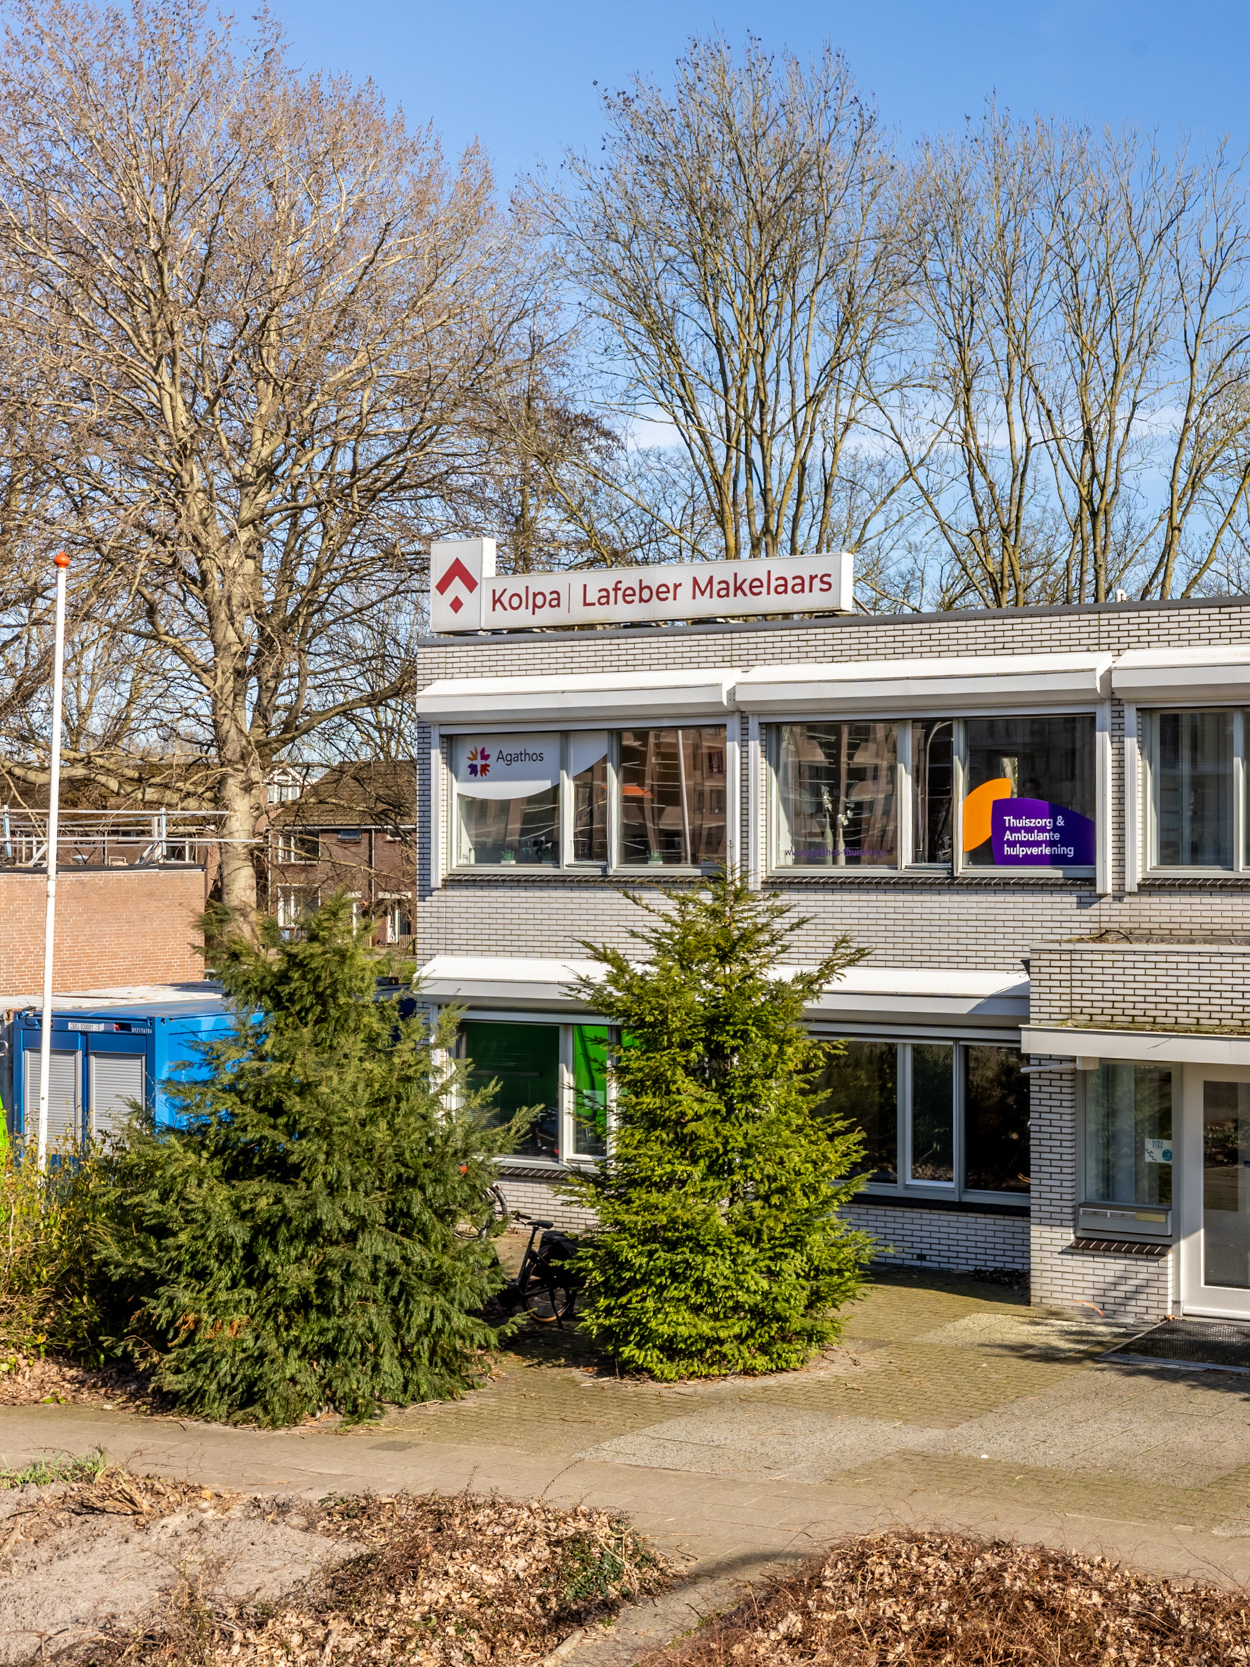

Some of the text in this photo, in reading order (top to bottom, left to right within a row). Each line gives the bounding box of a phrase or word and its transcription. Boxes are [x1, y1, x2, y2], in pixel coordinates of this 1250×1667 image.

[491, 586, 561, 615] Kolpa
[582, 579, 683, 608] Lafeber
[691, 570, 833, 600] Makelaars
[496, 748, 545, 766] Agathos
[1004, 815, 1065, 830] Thuiszorg &
[1004, 829, 1060, 841] Ambulante
[1004, 843, 1074, 858] hulpverlening
